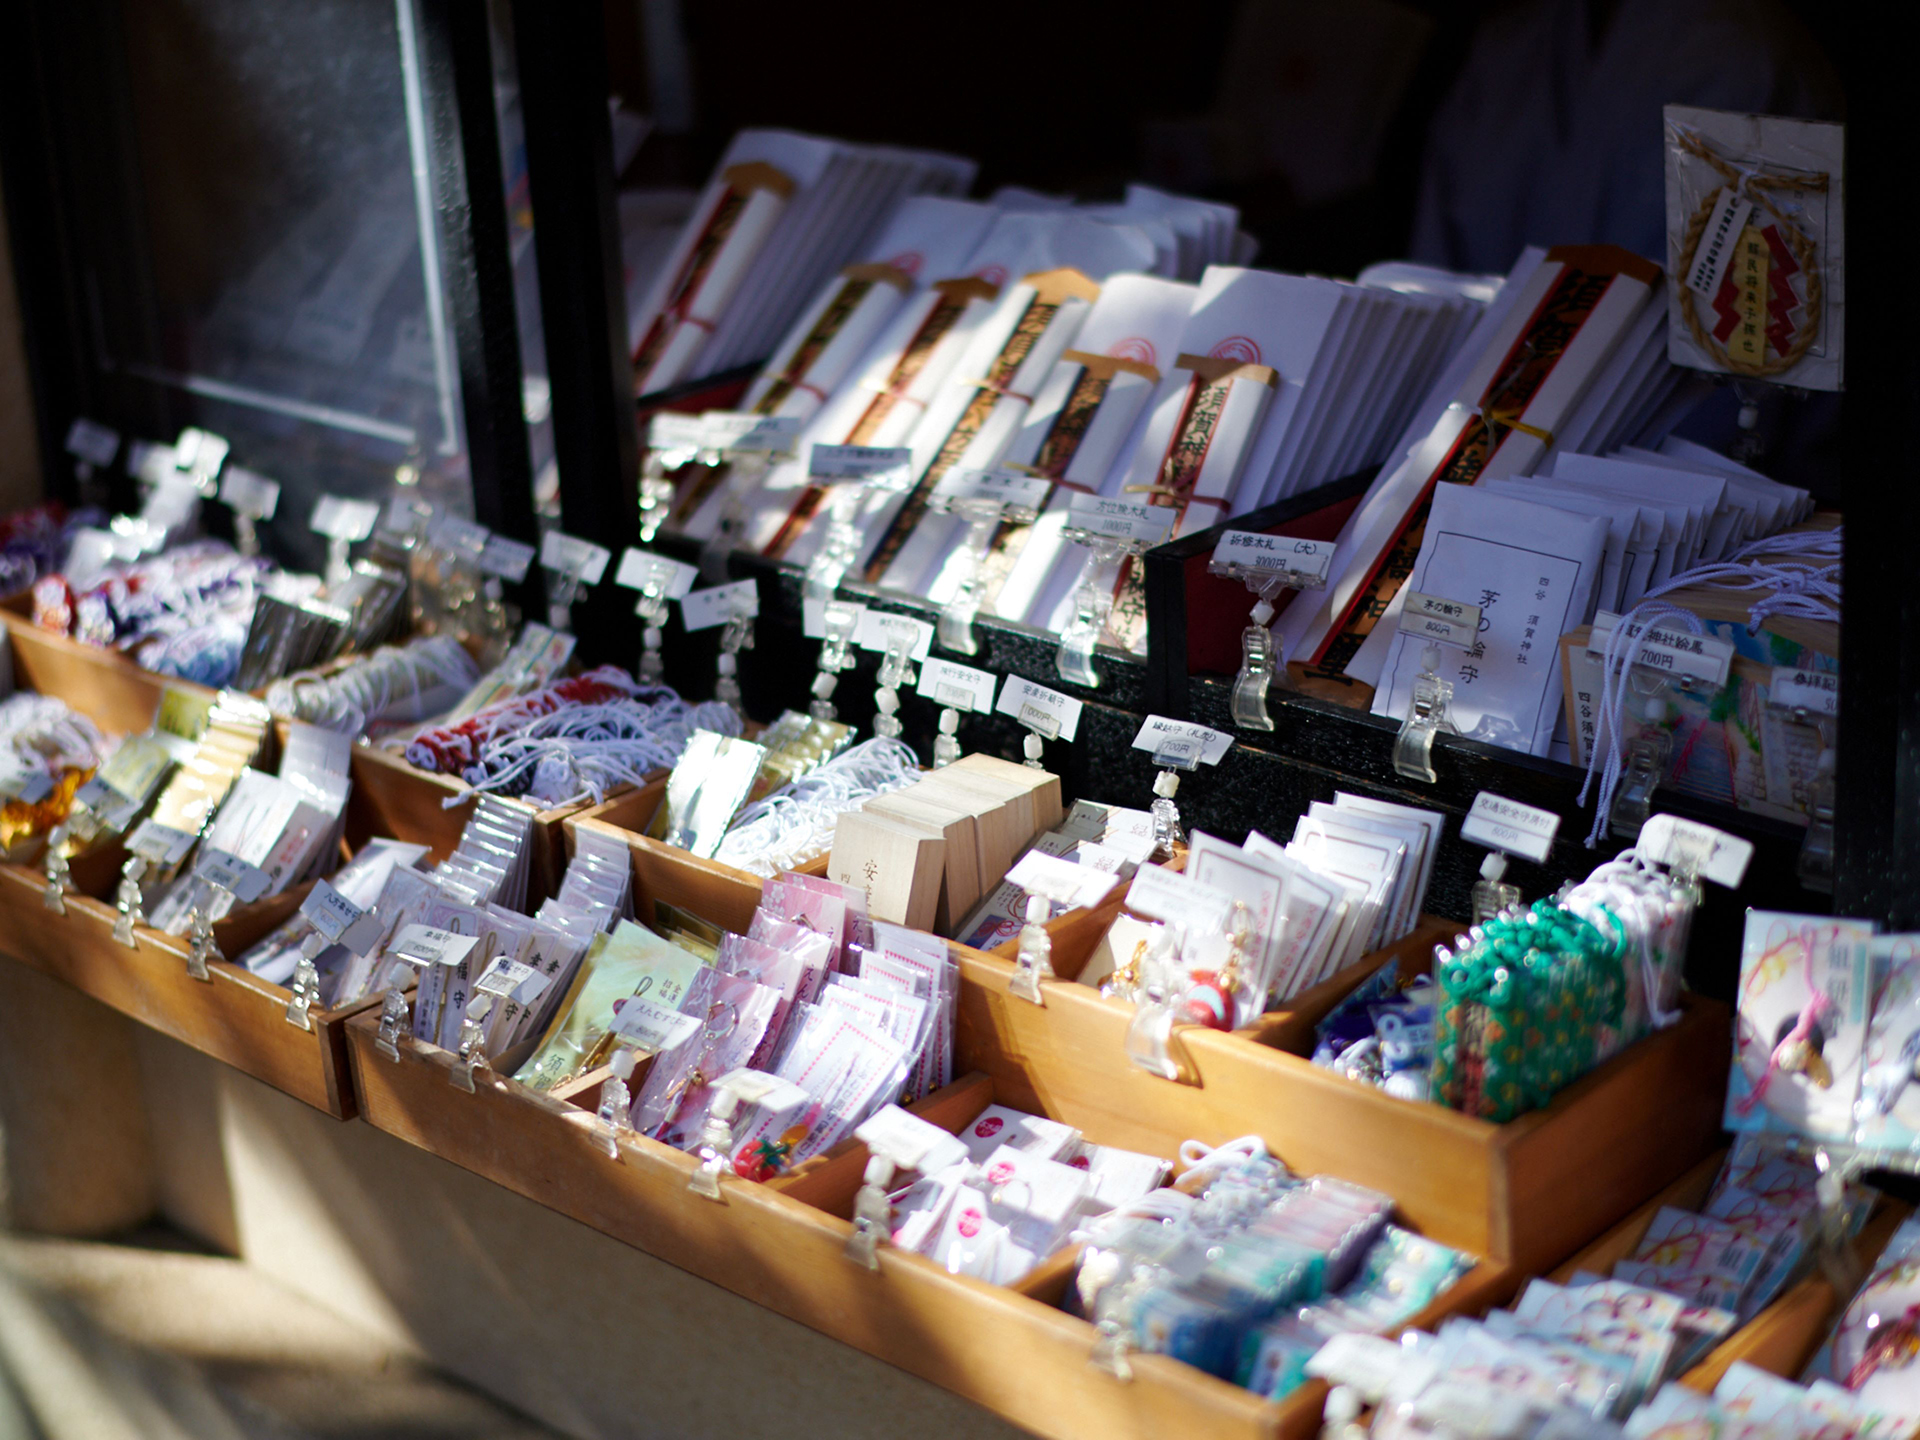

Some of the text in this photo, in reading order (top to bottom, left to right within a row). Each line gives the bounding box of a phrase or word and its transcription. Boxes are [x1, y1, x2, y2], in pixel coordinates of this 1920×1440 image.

[1423, 599, 1464, 618] 茅の輪守
[1424, 621, 1451, 637] 800円
[1516, 614, 1540, 666] 須賀神社
[1640, 649, 1674, 669] 700円
[1164, 741, 1190, 754] 700円
